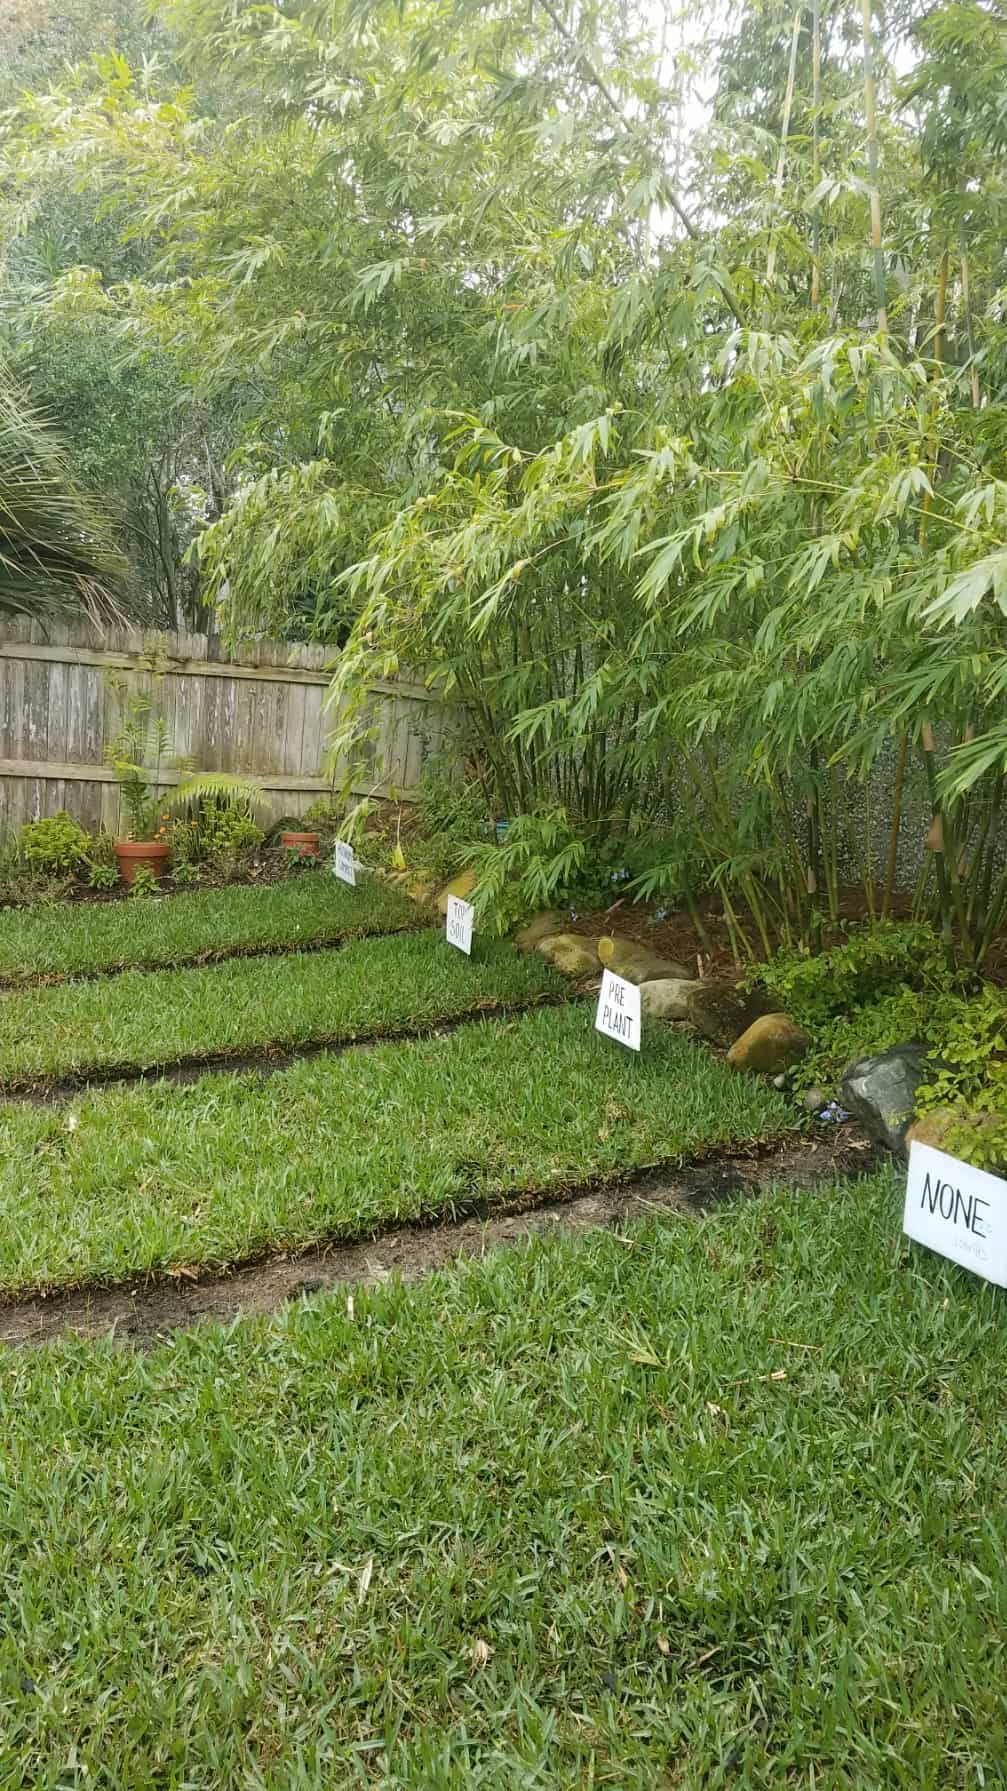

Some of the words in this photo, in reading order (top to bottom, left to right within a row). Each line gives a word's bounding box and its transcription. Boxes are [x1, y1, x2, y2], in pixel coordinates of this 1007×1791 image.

[609, 981, 625, 1006] PRE
[602, 1005, 633, 1038] PLANT
[920, 1172, 991, 1238] NONE
